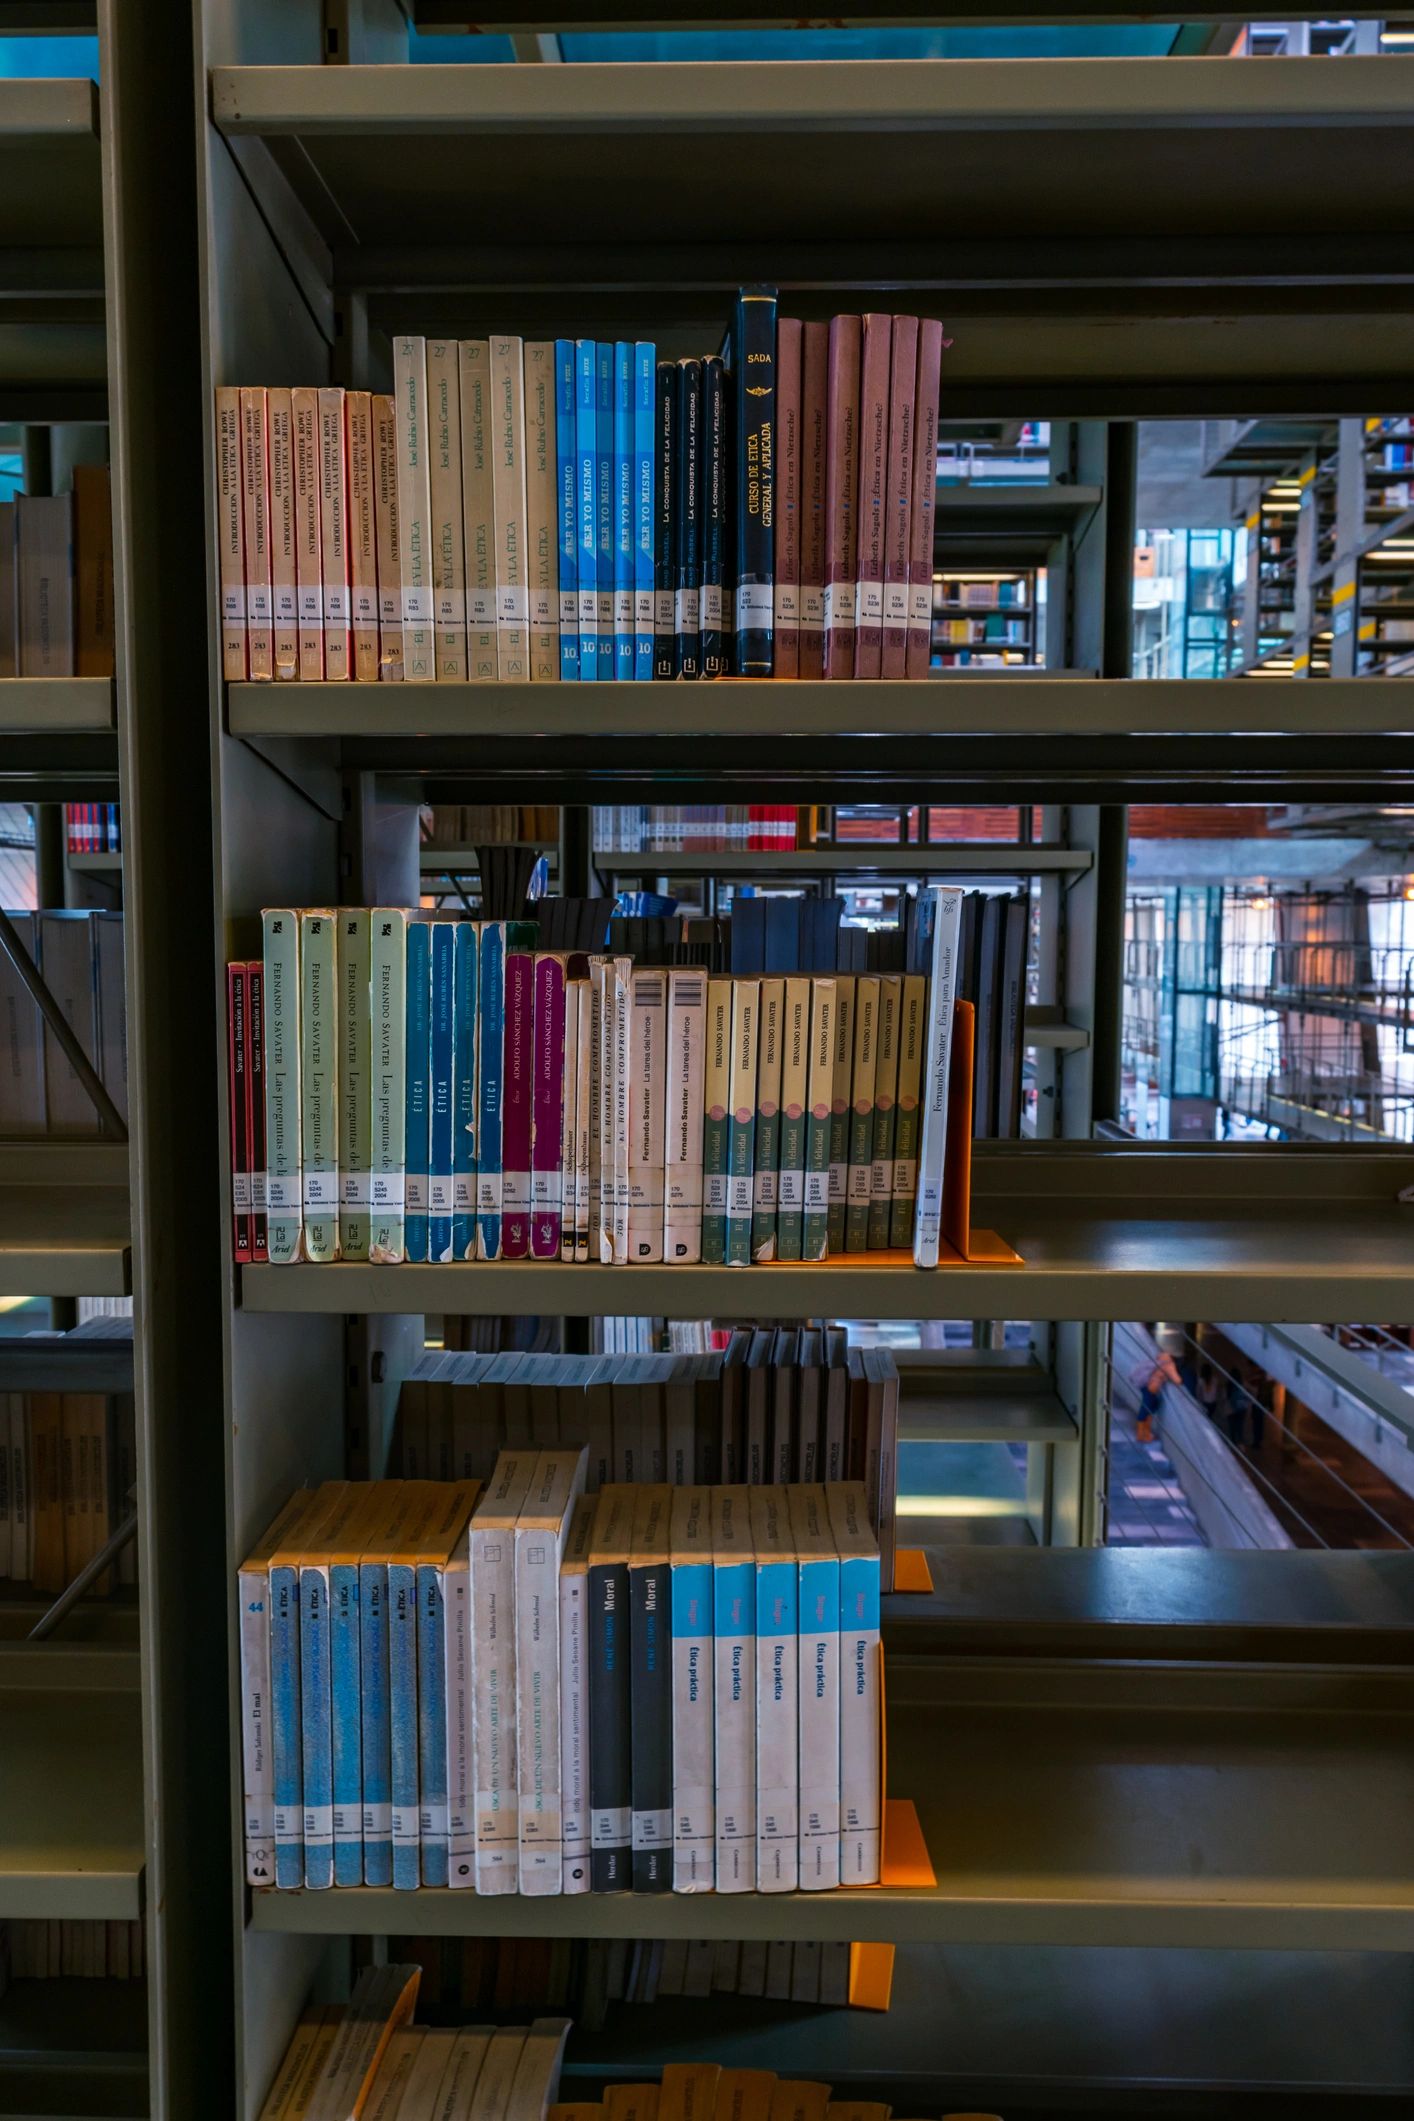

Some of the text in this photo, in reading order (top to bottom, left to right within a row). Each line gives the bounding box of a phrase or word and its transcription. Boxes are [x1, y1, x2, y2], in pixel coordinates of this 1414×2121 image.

[402, 345, 414, 355] 27
[747, 353, 771, 363] SADA
[406, 377, 418, 467] José Rubio Carracedo
[664, 440, 670, 449] LA
[664, 452, 670, 463] DE
[689, 436, 695, 445] LA
[689, 449, 695, 459] DE
[761, 422, 771, 470] APLICADA
[230, 470, 236, 480] LA
[333, 474, 339, 484] LA
[748, 433, 759, 514] CURSO DE ETICA
[583, 459, 592, 548] SER YO MISMO
[621, 463, 630, 551] SER YO MISMO
[641, 460, 650, 549] SER YO MISMO
[663, 513, 670, 523] LA
[688, 510, 694, 520] LA
[762, 483, 772, 527] GENERAL
[230, 493, 238, 554] INTRODUCCION
[411, 520, 420, 552] ÉTICA
[870, 508, 880, 576] Lizbeth Sagols
[896, 509, 906, 576] Lizbeth Sagols
[582, 641, 595, 653] 10
[639, 641, 651, 654] 10
[513, 970, 522, 1008] VÁZQUEZ
[544, 970, 552, 1008] VÁZQUEZ
[235, 1009, 243, 1041] Invitación
[512, 1010, 521, 1046] SÁNCHEZ
[543, 1010, 551, 1046] SÁNCHEZ
[715, 1005, 724, 1068] FERNANDO SAVATER
[742, 1006, 751, 1070] FERNANDO SAVATER
[820, 1004, 829, 1066] FERNANDO SAVATER
[932, 947, 952, 1113] Fernando Savater Ética para Amador
[235, 1050, 243, 1073] Savater
[682, 1039, 690, 1051] del
[313, 1072, 324, 1092] Las
[382, 1074, 392, 1094] Las
[643, 1073, 650, 1082] La
[682, 1073, 689, 1082] La
[310, 1096, 322, 1149] preguntas
[379, 1098, 391, 1152] preguntas
[592, 1127, 599, 1139] EL
[642, 1122, 650, 1161] Fernando
[680, 1122, 688, 1161] Fernando
[738, 1134, 746, 1164] felicidad
[313, 1153, 325, 1166] de
[382, 1155, 393, 1168] de
[604, 1579, 615, 1611] Moral
[645, 1579, 656, 1611] Moral
[688, 1647, 700, 1701] Ética práctica
[731, 1646, 743, 1700] Ética práctica
[773, 1645, 785, 1700] Ética práctica
[815, 1643, 827, 1697] Ética práctica
[855, 1640, 867, 1694] Ética práctica
[252, 1693, 261, 1718] El mal
